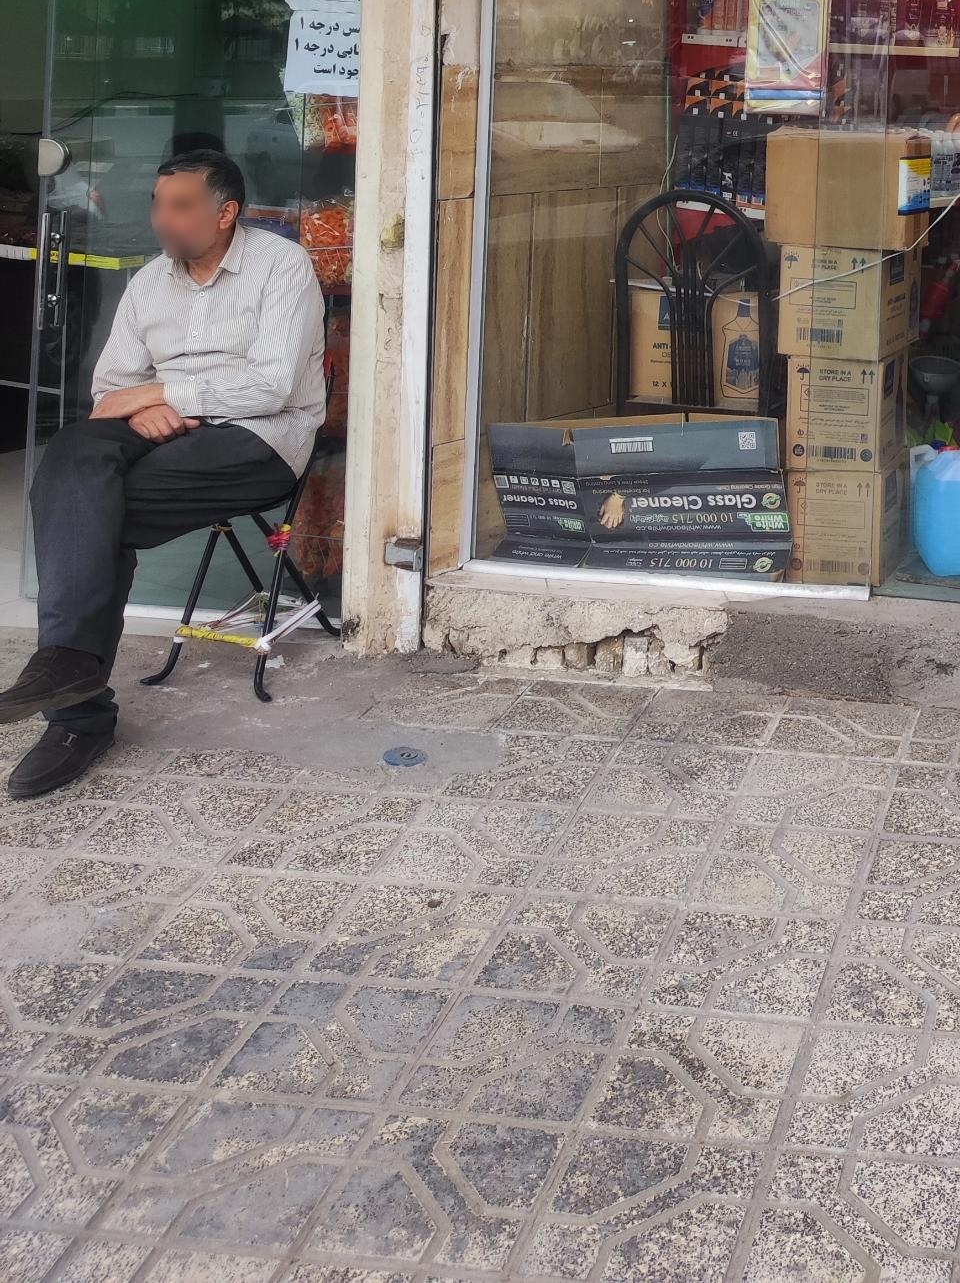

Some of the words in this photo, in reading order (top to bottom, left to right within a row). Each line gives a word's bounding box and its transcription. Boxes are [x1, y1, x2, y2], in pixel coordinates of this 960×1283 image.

[309, 20, 340, 36] درجه
[303, 42, 335, 58] درجه
[313, 63, 337, 74] است
[502, 494, 547, 507] Cleaner
[549, 497, 578, 510] Glass
[630, 495, 703, 513] Cleaner
[706, 493, 757, 511] Glass
[671, 513, 692, 525] 715
[696, 513, 718, 523] 000
[720, 512, 734, 523] 10
[649, 557, 672, 568] 715
[675, 558, 697, 568] 000
[700, 558, 714, 569] 10
